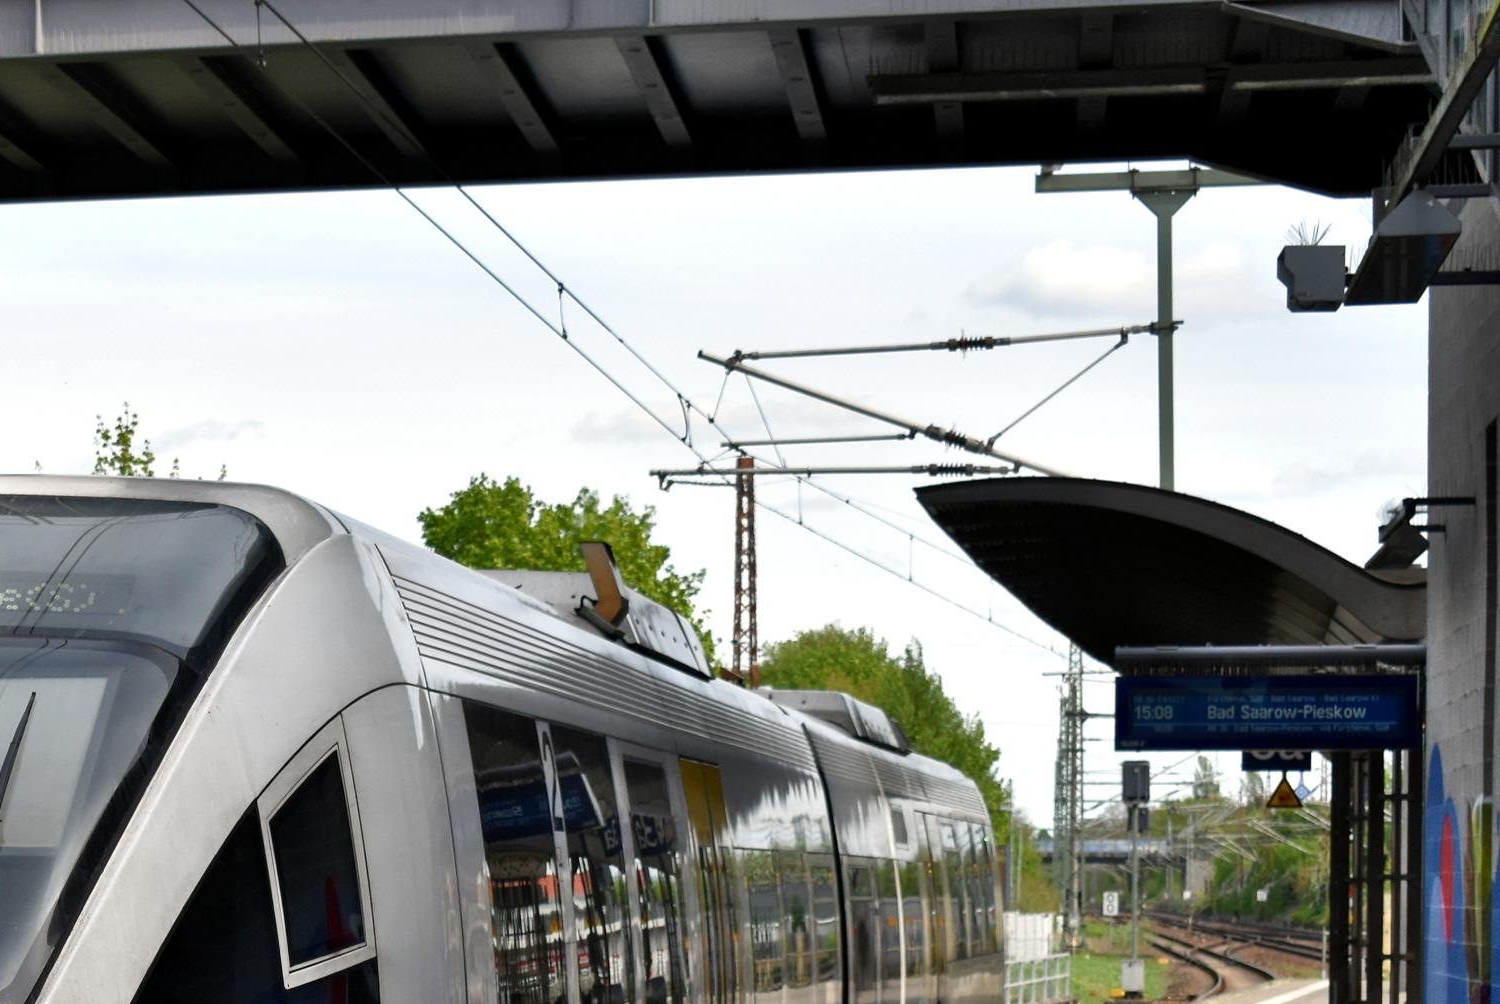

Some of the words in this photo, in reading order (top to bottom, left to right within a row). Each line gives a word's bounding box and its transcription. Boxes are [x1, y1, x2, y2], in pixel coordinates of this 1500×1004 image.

[1134, 704, 1173, 720] 15:08
[1207, 704, 1235, 720] Bad
[1241, 704, 1367, 720] Saarow-Pieskow
